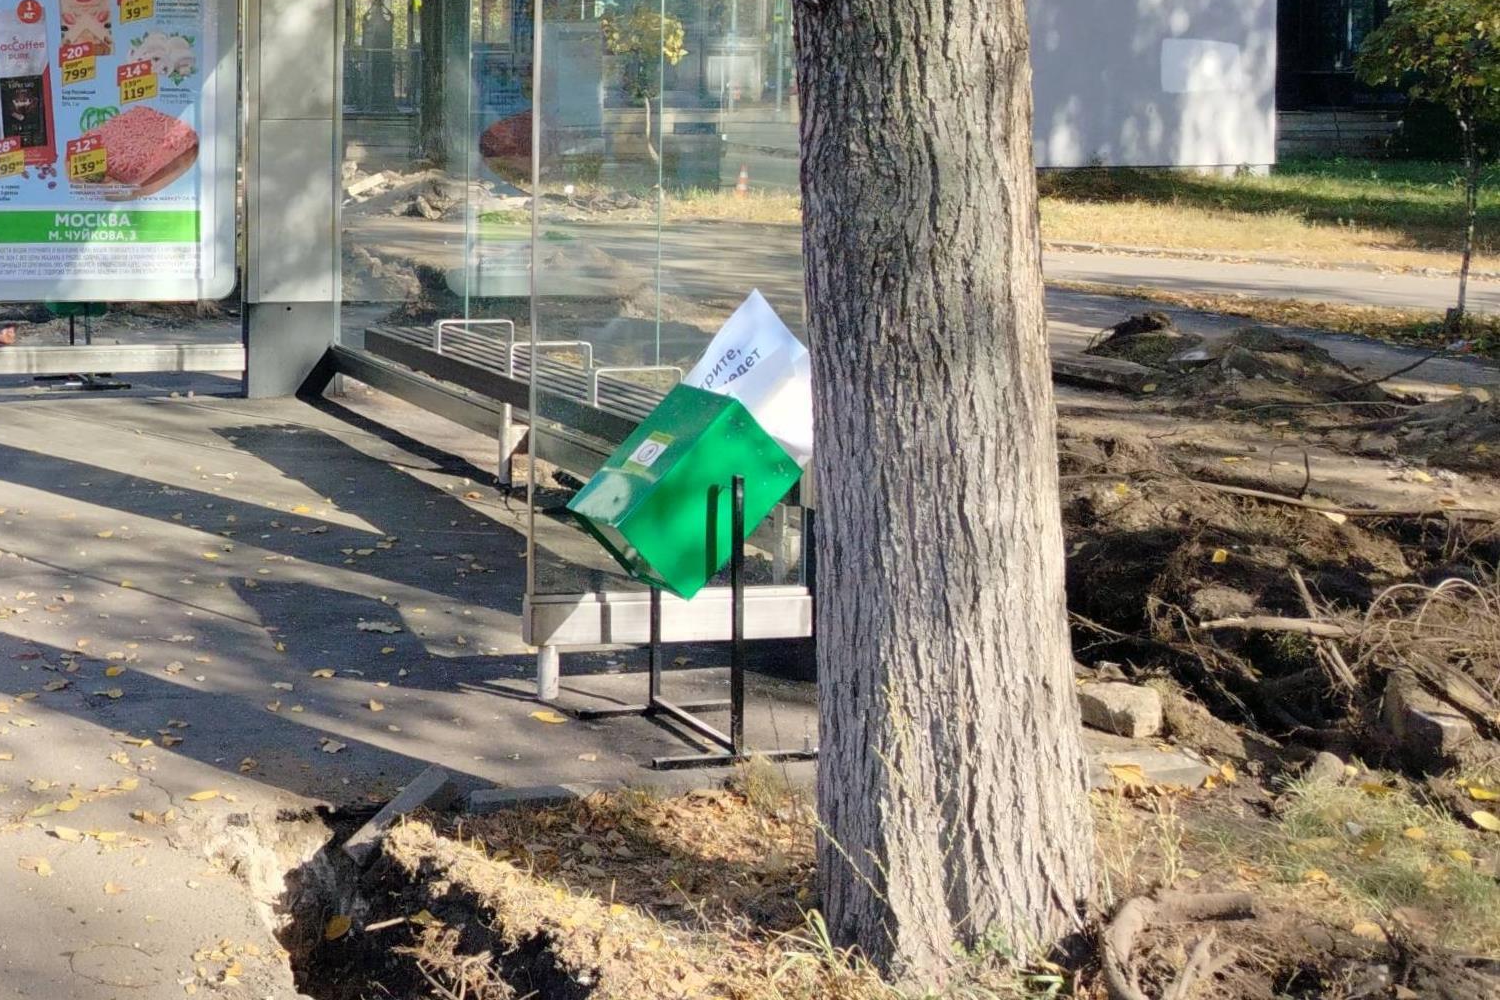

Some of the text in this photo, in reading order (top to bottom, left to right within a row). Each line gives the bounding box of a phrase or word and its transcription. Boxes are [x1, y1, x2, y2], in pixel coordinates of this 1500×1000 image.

[55, 213, 131, 227] МОСКВА
[49, 231, 63, 241] М.
[724, 348, 760, 384] едет
